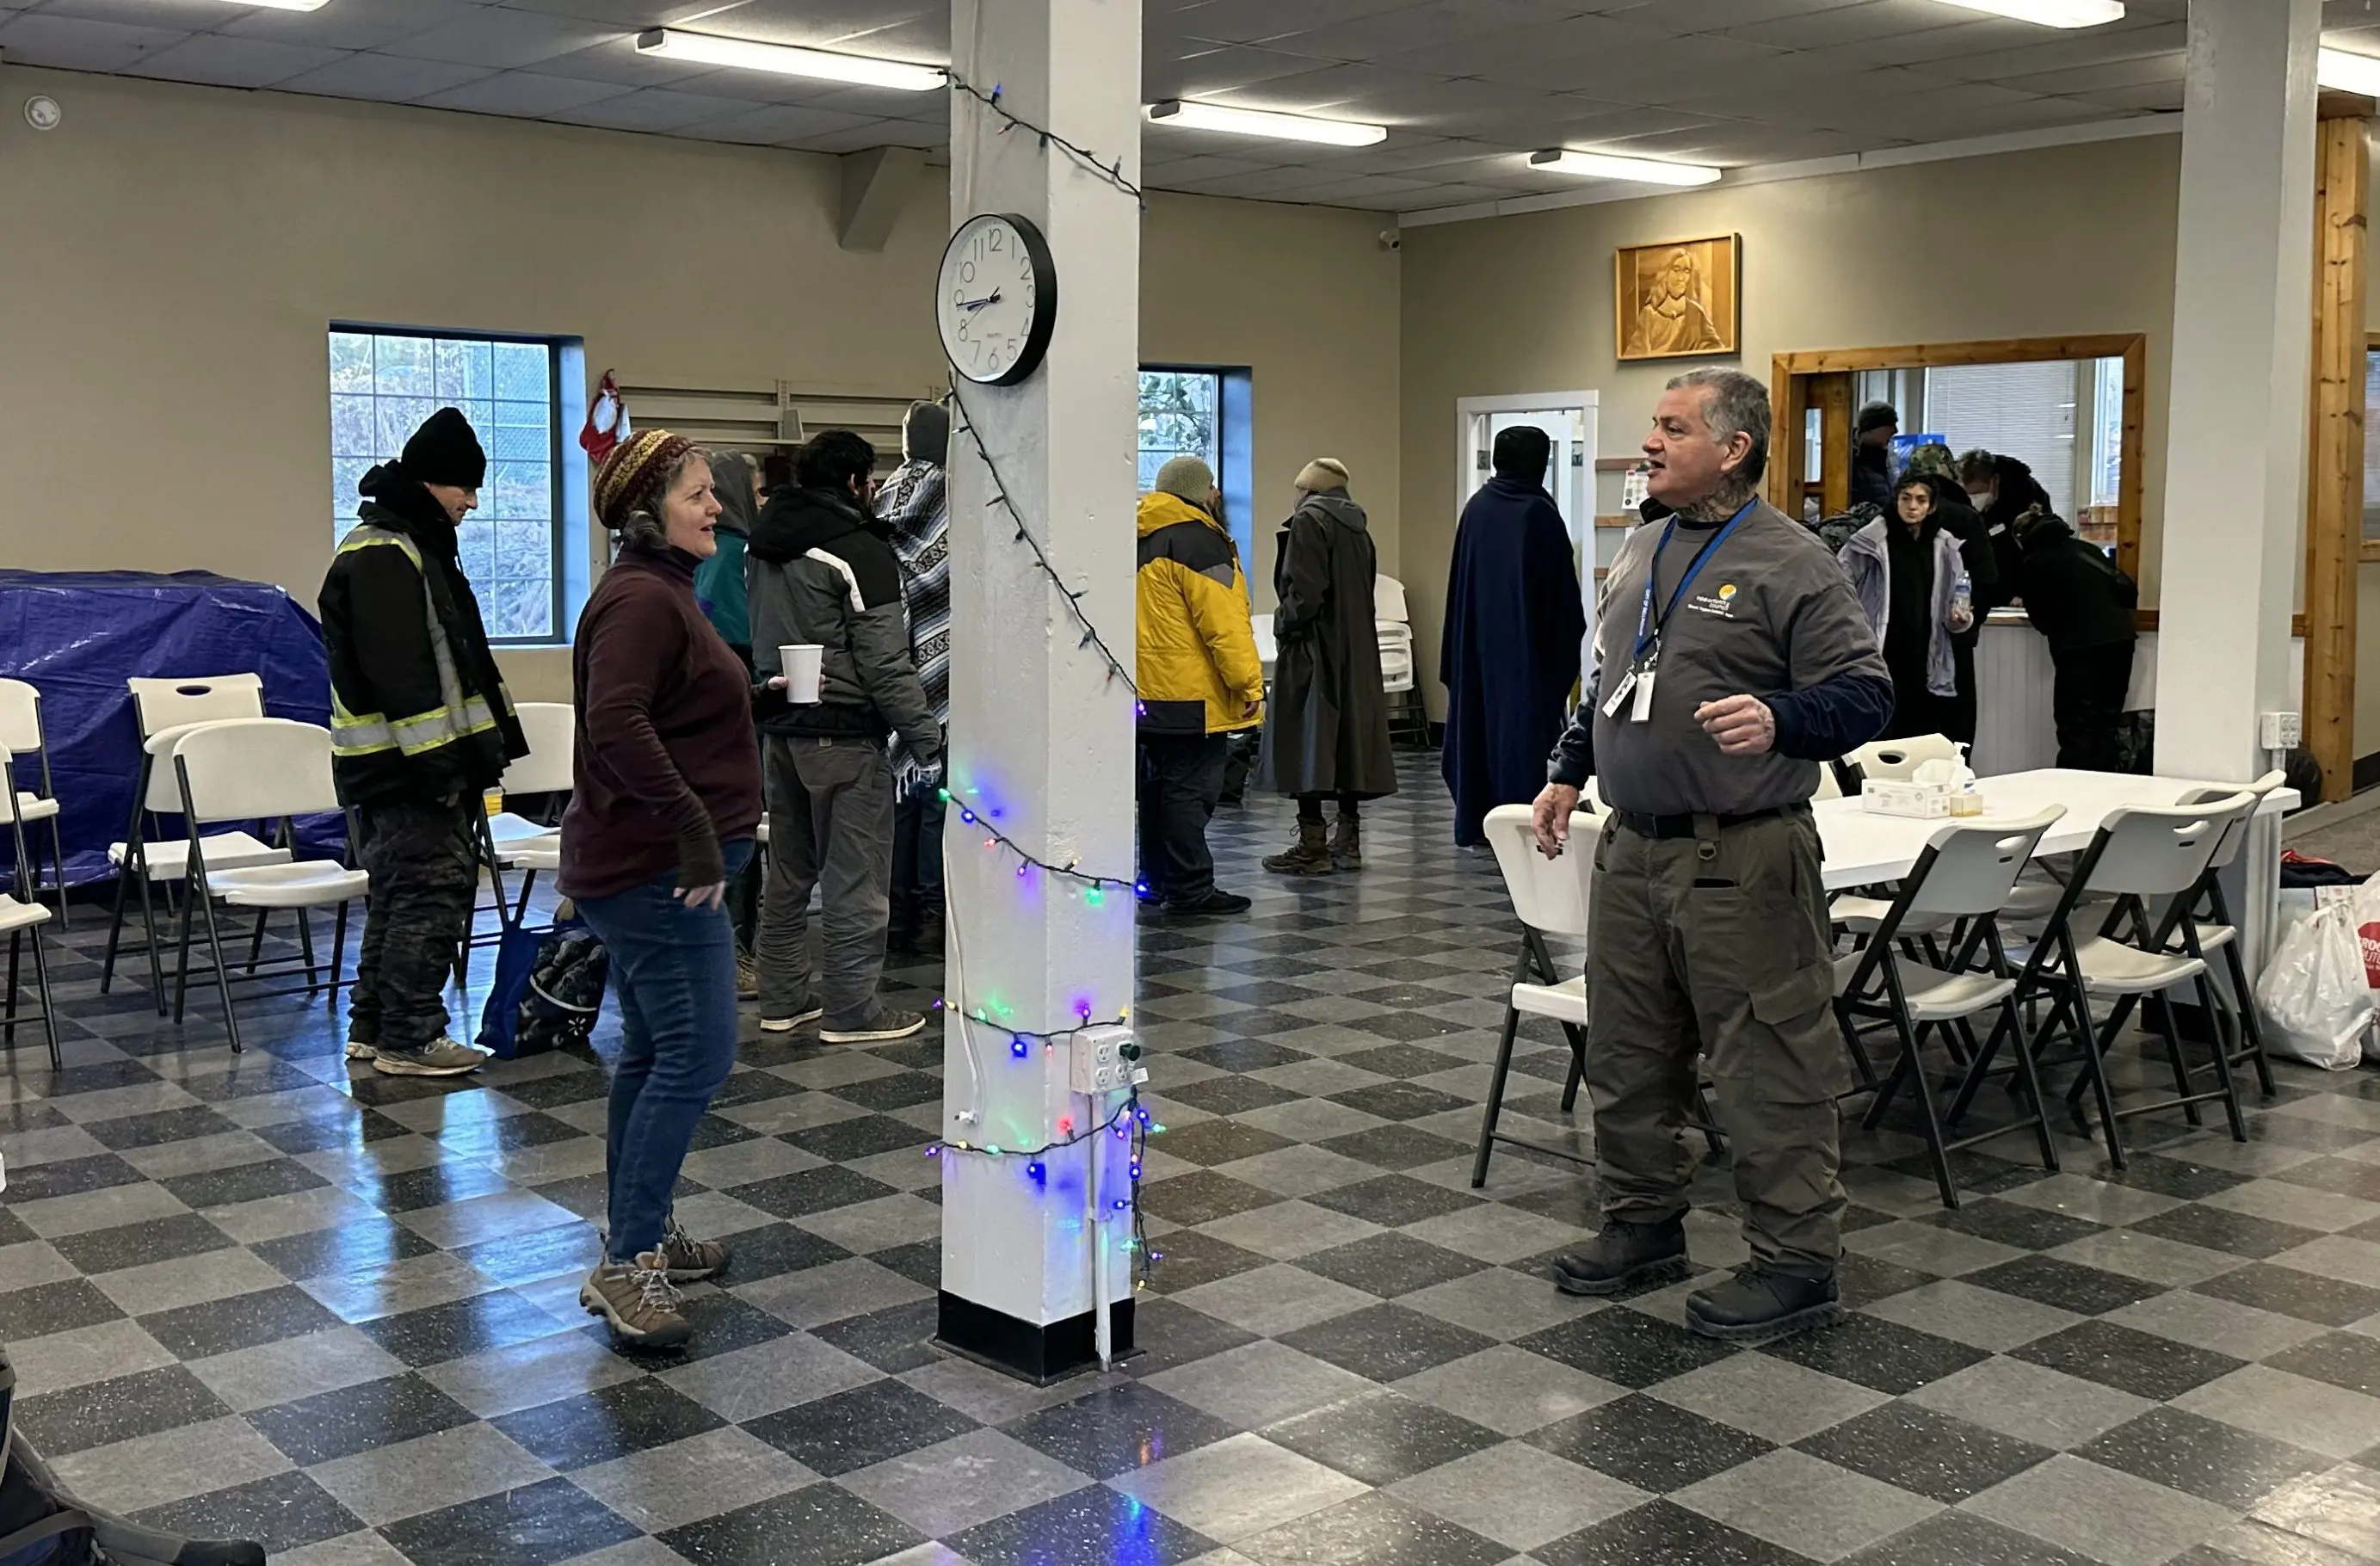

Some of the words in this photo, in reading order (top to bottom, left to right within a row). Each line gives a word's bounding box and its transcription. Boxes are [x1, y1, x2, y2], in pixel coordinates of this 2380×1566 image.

[973, 237, 983, 262] 11
[990, 228, 1002, 252] 12
[959, 261, 976, 284] 10
[1020, 256, 1033, 281] 2
[953, 288, 965, 311] 9
[1025, 284, 1035, 308] 3
[958, 318, 968, 342] 8
[1020, 317, 1030, 336] 4
[971, 340, 981, 364] 7
[988, 347, 1000, 371] 6
[1007, 338, 1018, 361] 5
